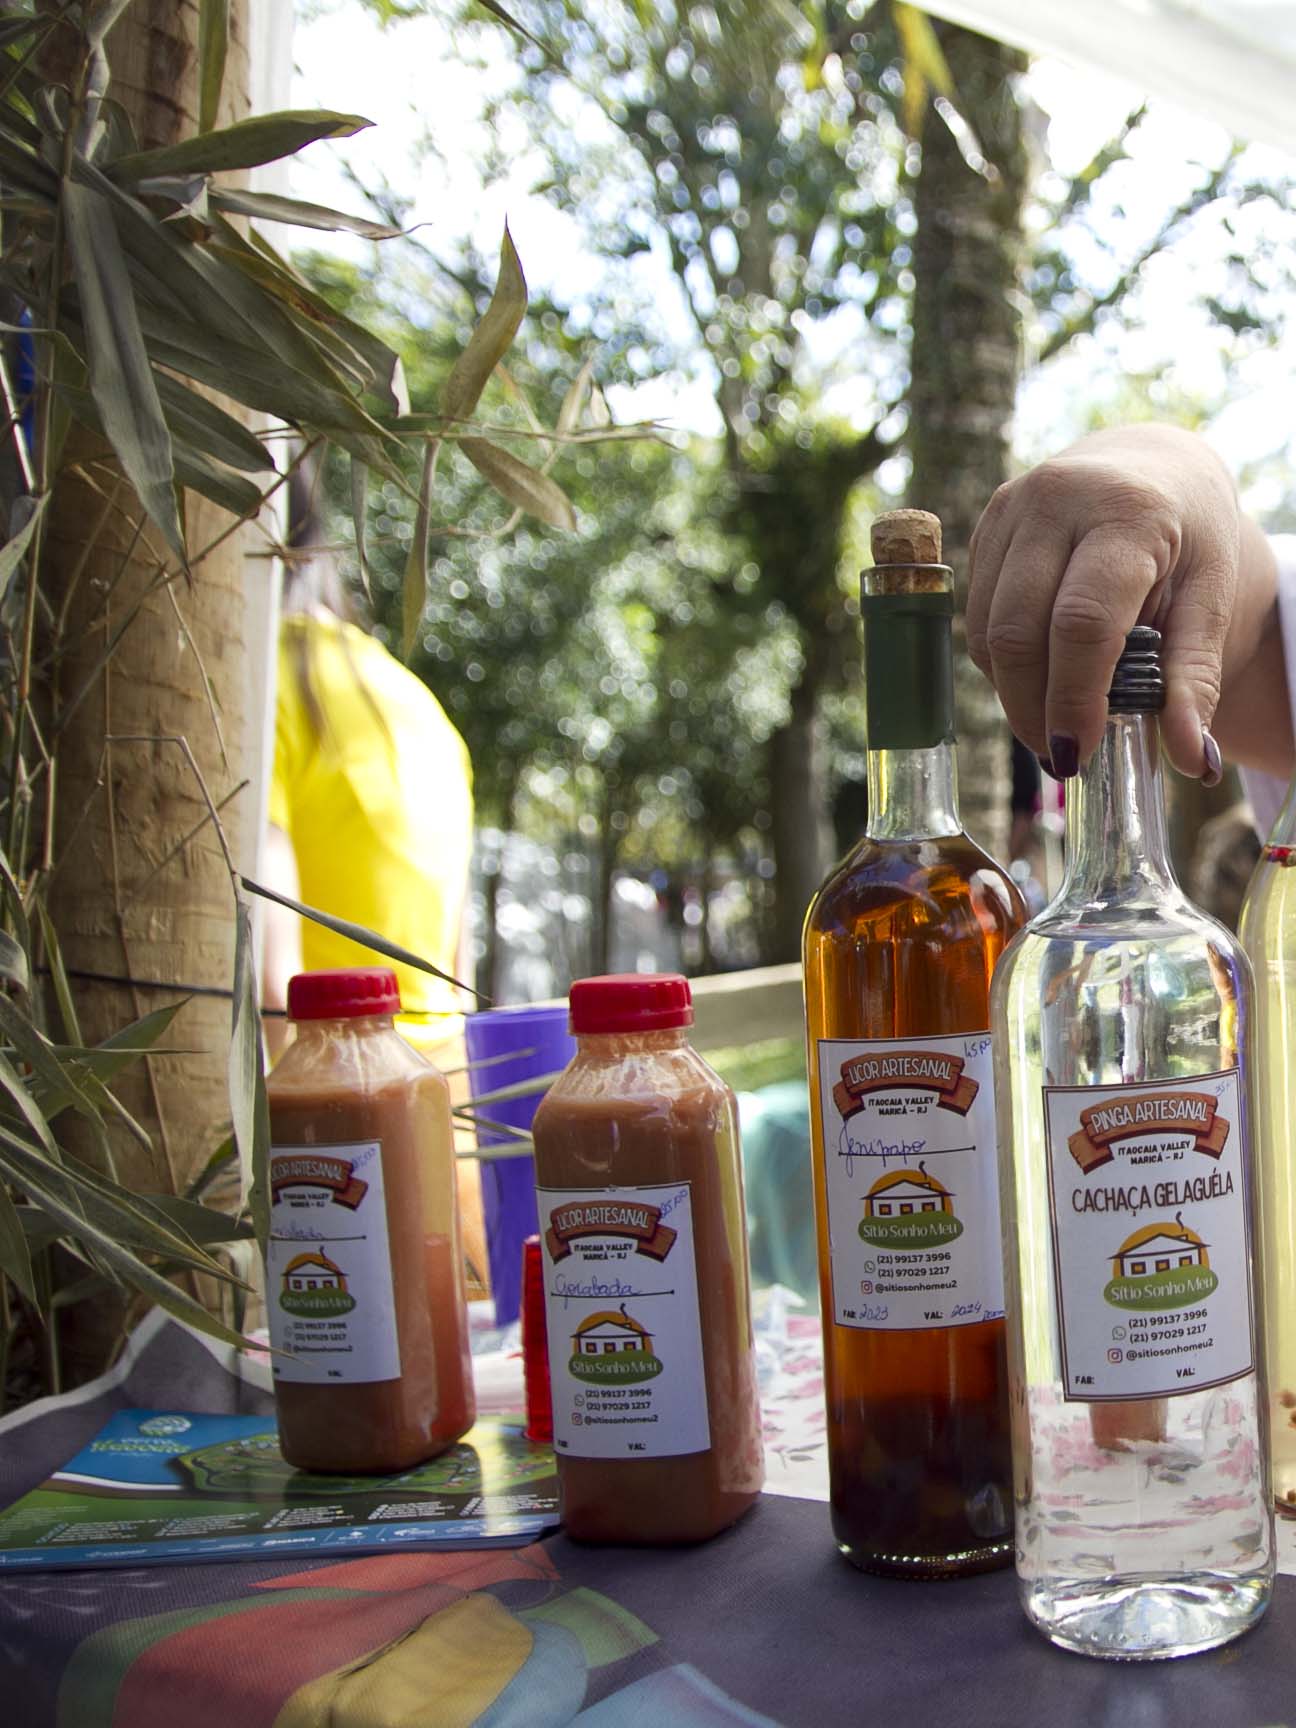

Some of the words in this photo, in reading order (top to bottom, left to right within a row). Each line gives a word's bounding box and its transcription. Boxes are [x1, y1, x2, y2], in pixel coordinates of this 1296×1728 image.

[848, 1060, 880, 1084] LICOR
[881, 1058, 951, 1080] ARTESANAL
[868, 1098, 903, 1106] ITAOCAIA
[905, 1096, 935, 1105] VALLEY
[878, 1106, 907, 1116] MARICÁ
[917, 1106, 927, 1114] RJ
[1091, 1106, 1134, 1134] PINGA
[1135, 1099, 1207, 1124] ARTESANAL
[1118, 1145, 1158, 1156] ITAOCAIA
[1161, 1140, 1191, 1151] VALLEY
[1130, 1154, 1163, 1165] MARICÁ
[1173, 1152, 1184, 1161] RJ
[1072, 1184, 1152, 1217] CACHAÇA
[1154, 1168, 1234, 1207] GELAGUÉLA
[557, 1208, 584, 1230] LICOR
[585, 1206, 649, 1229] ARTESANAL
[890, 1223, 928, 1237] Sonho
[930, 1223, 957, 1236] Meu
[606, 1243, 633, 1251] VALLEY
[877, 1254, 893, 1264] (21)
[895, 1254, 923, 1263] 99137
[926, 1252, 951, 1261] 3996
[878, 1269, 894, 1278] (21)
[896, 1268, 926, 1277] 97029
[929, 1266, 950, 1275] 1217
[875, 1280, 957, 1293] @sitiosonhomeu2
[1144, 1281, 1185, 1299] Sonho
[1187, 1277, 1213, 1293] Meu
[924, 1311, 944, 1320] VAL:
[1129, 1317, 1148, 1329] (21)
[1150, 1314, 1181, 1327] 99137
[1183, 1308, 1208, 1322] 3996
[1130, 1333, 1149, 1344] (21)
[1151, 1329, 1184, 1341] 97029
[1186, 1324, 1207, 1335] 1217
[1126, 1338, 1214, 1361] @sitiosonhomeu2
[597, 1359, 630, 1373] Sonho
[631, 1360, 658, 1372] Meu
[1176, 1368, 1196, 1378] VAL:
[1075, 1375, 1095, 1385] FAB:
[602, 1402, 629, 1410] 97029
